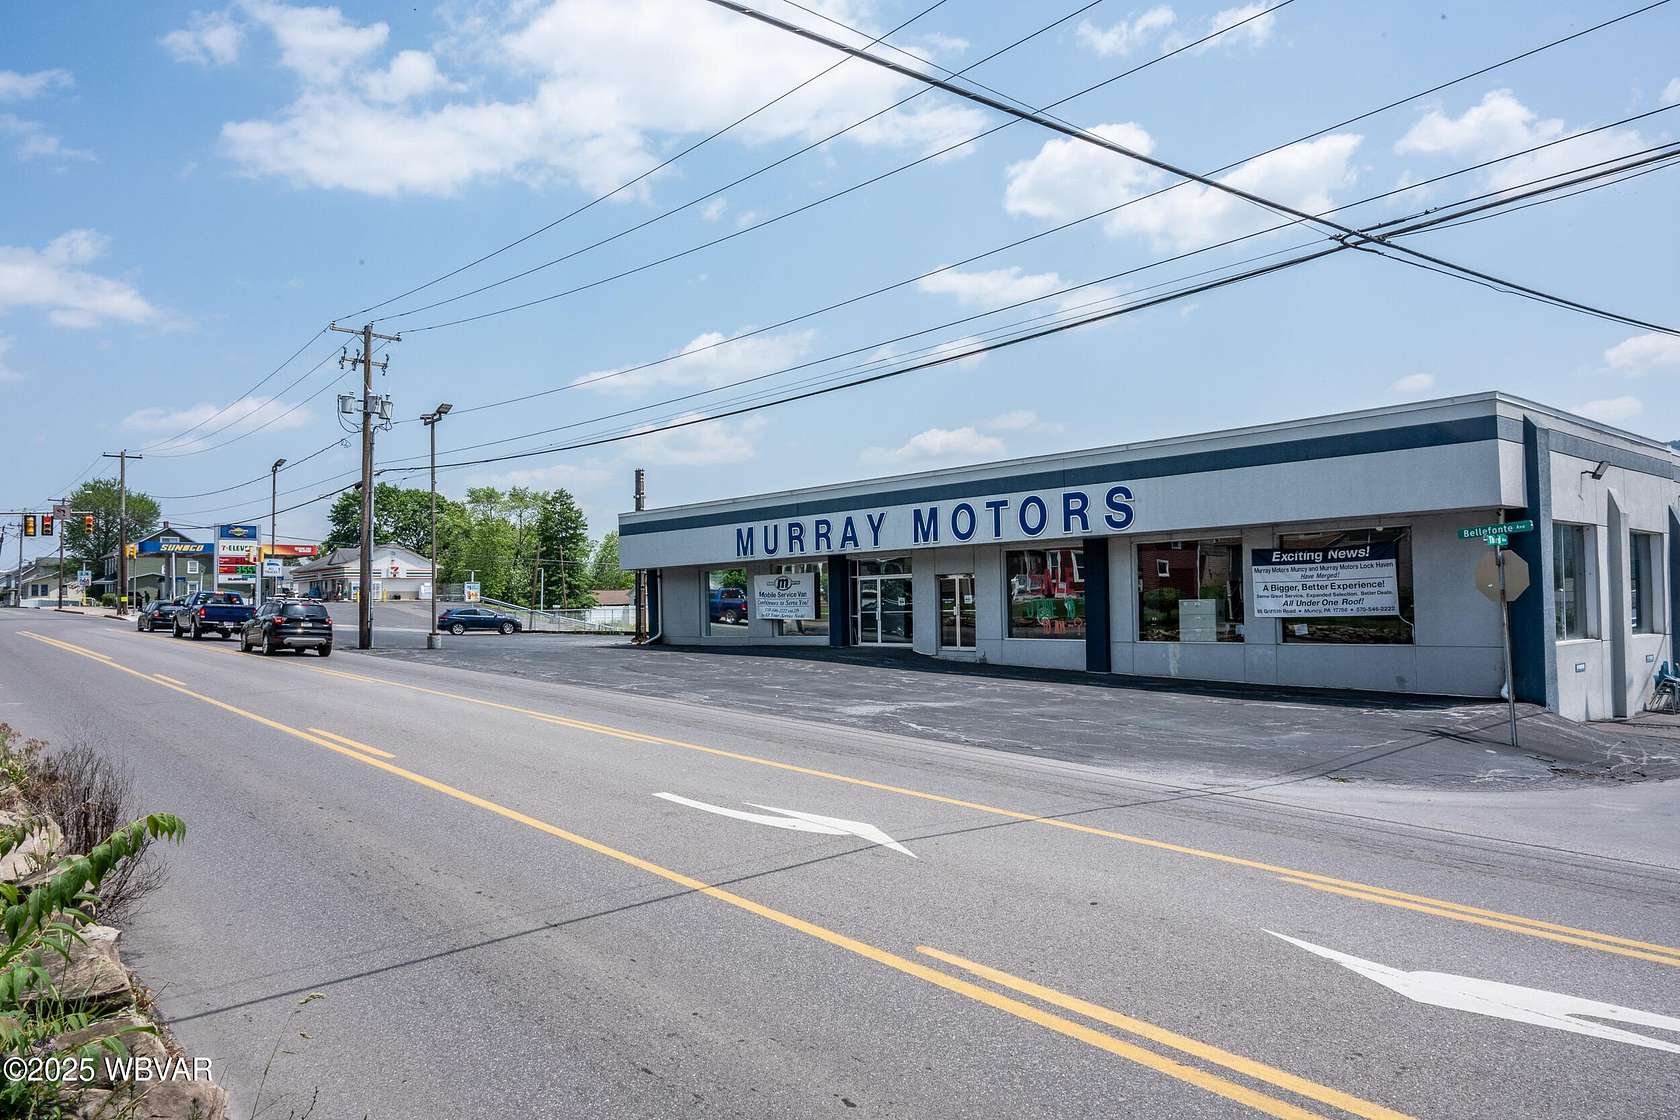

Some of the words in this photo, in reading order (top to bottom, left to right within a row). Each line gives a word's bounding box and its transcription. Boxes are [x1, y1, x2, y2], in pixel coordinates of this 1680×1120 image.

[736, 512, 887, 558] MURRAY
[913, 485, 1135, 544] MOTORS
[1463, 525, 1513, 538] Bellefonte
[1272, 551, 1322, 562] Exciting
[1328, 546, 1370, 560] News!
[1271, 584, 1300, 593] Bigger,
[1330, 580, 1385, 590] Experience!
